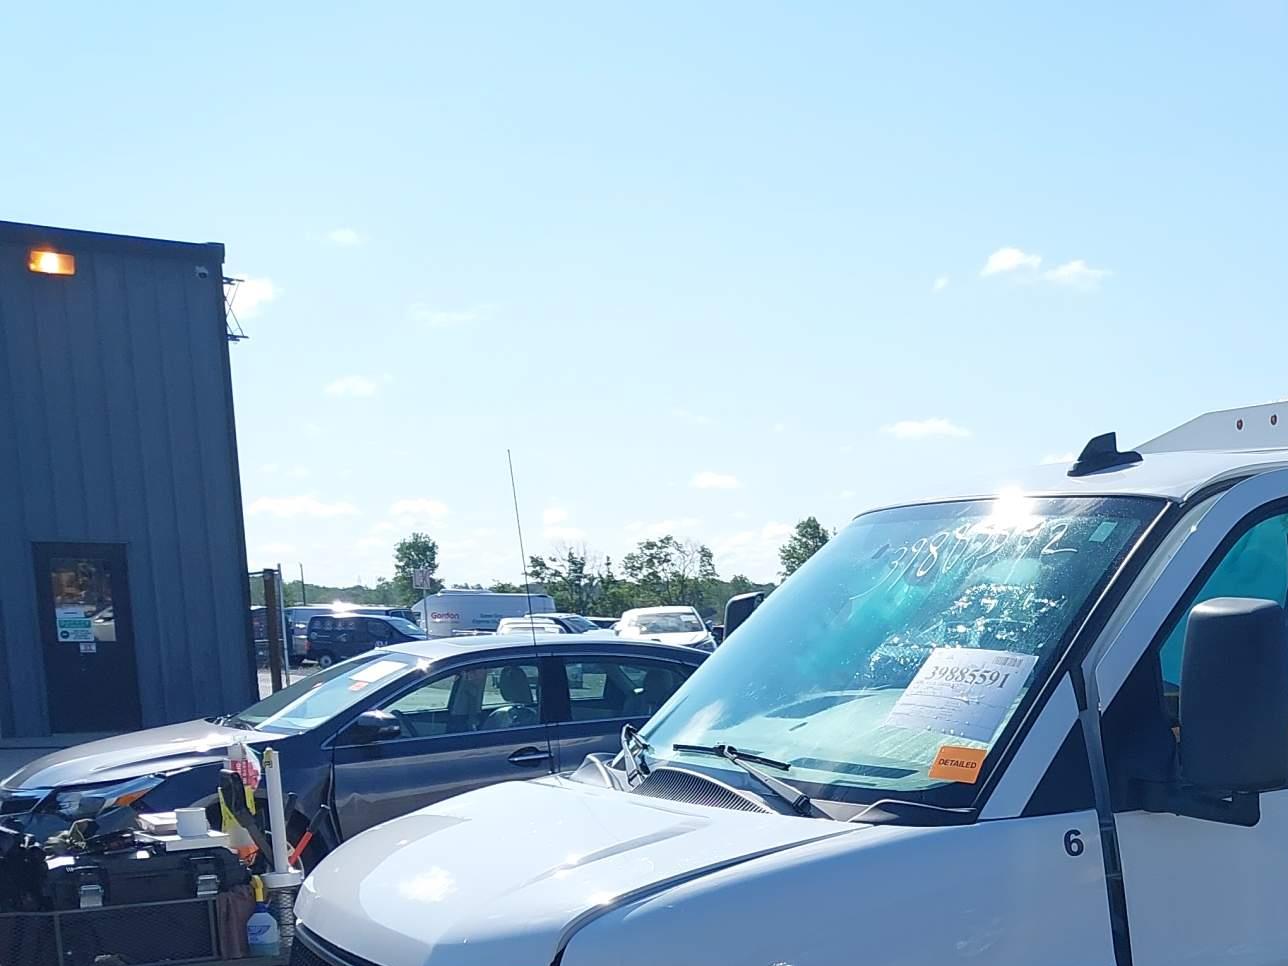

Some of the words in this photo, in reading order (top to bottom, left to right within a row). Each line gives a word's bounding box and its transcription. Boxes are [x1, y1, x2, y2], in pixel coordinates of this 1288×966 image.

[924, 666, 1010, 688] 39885591
[938, 757, 977, 770] DETAILED
[1063, 829, 1084, 857] 6
